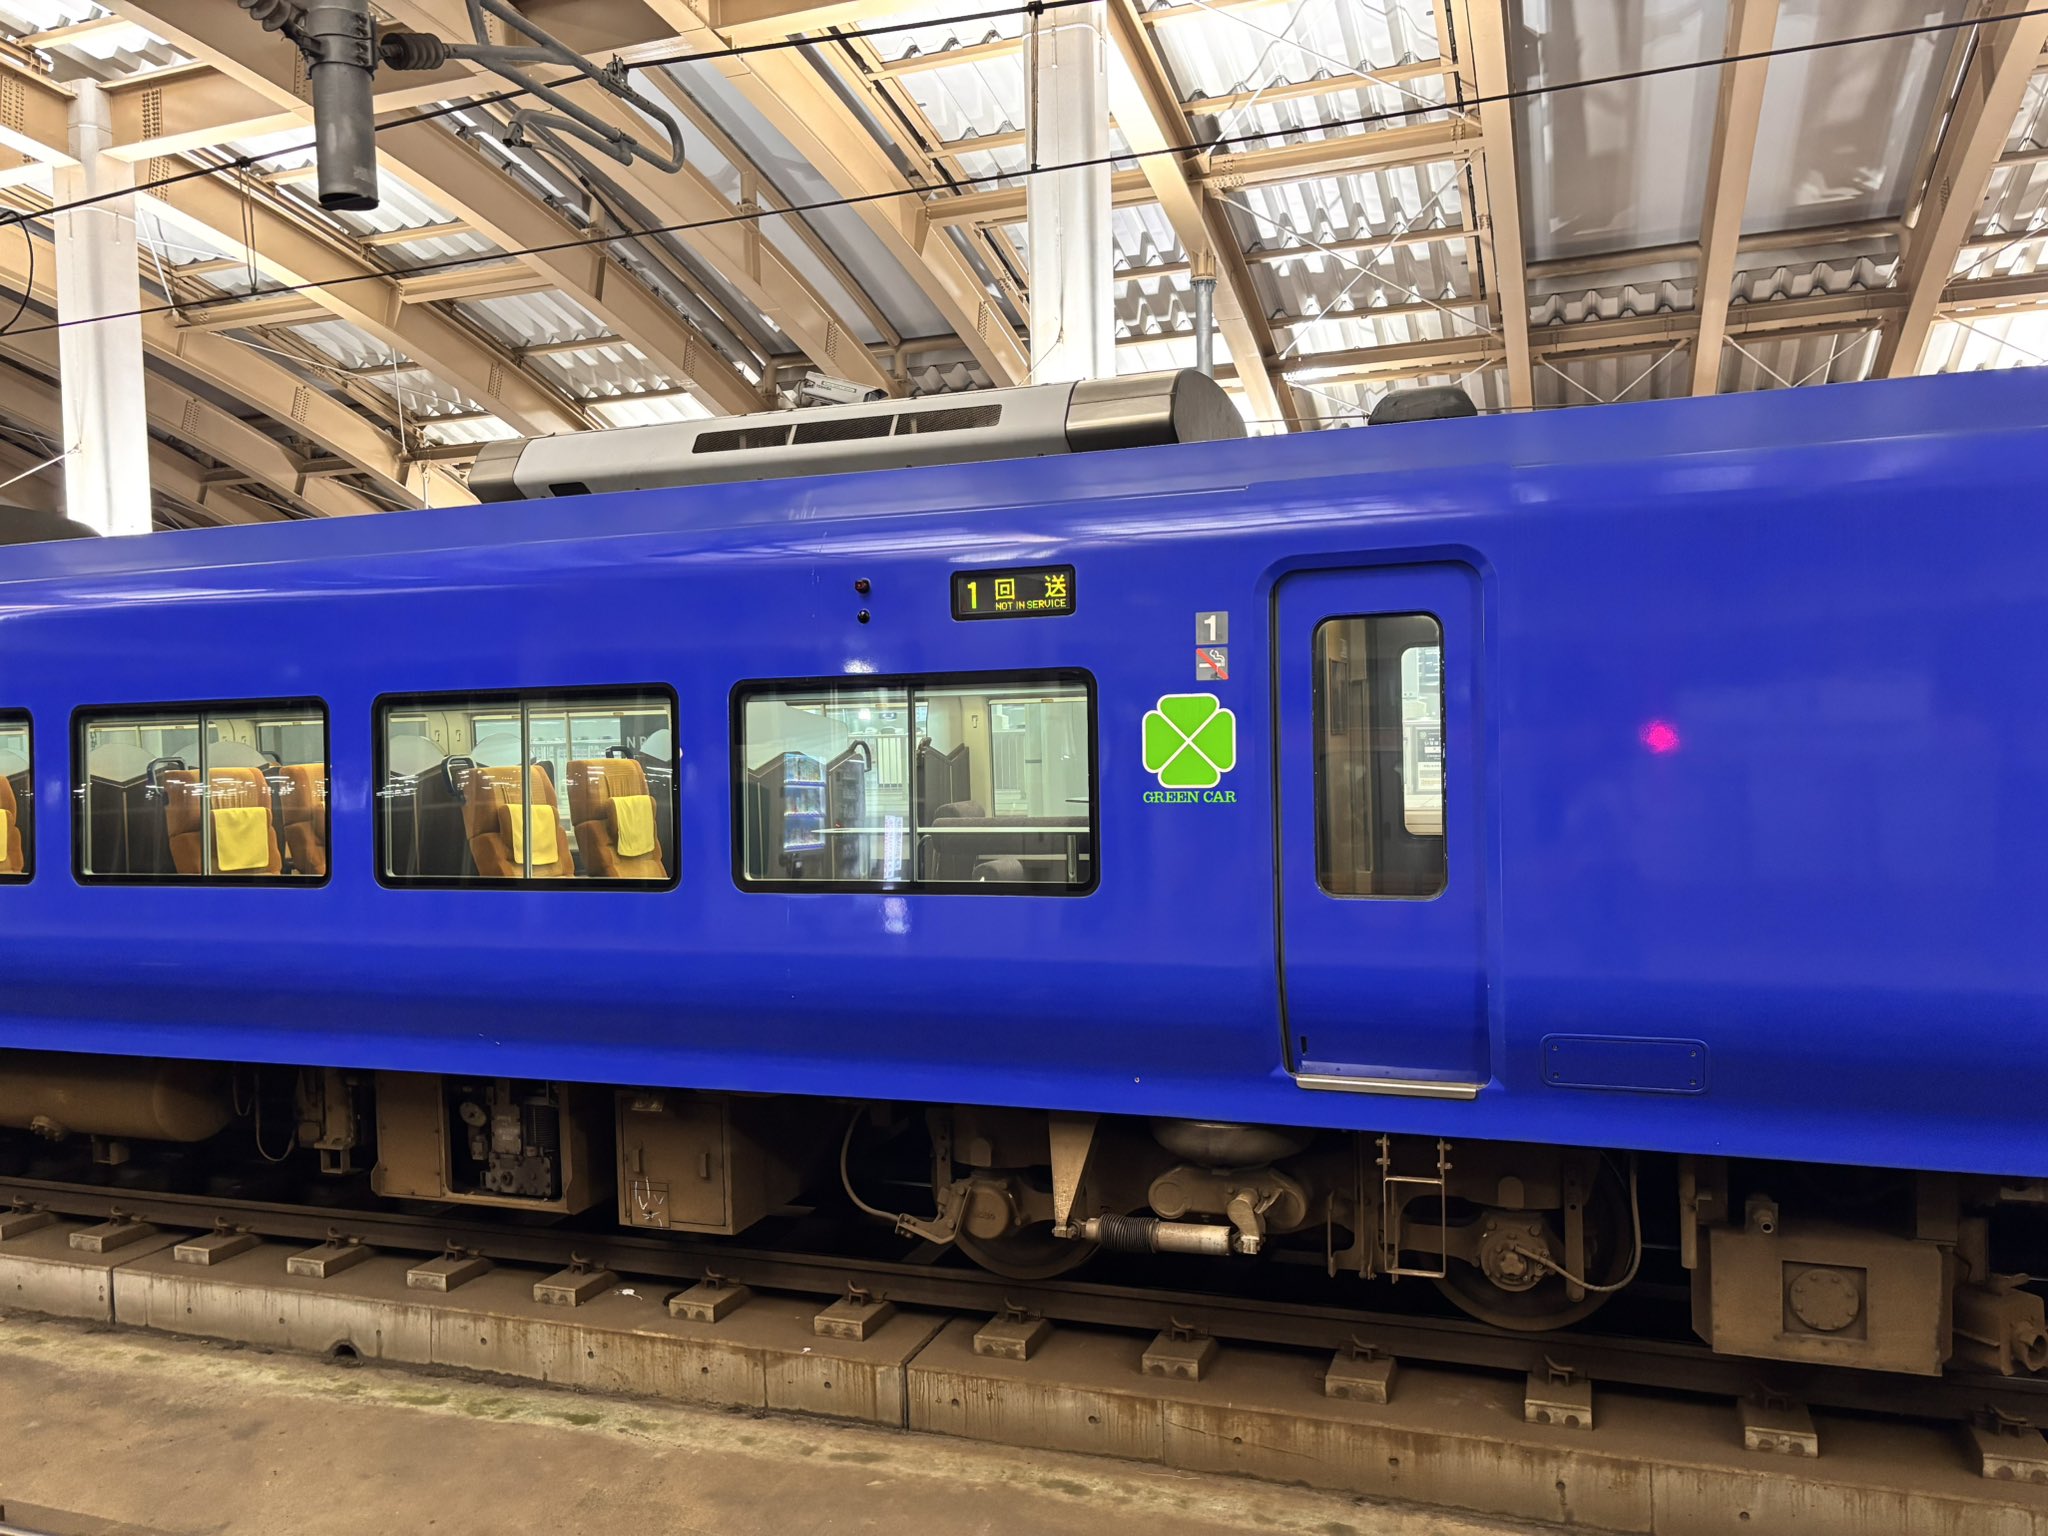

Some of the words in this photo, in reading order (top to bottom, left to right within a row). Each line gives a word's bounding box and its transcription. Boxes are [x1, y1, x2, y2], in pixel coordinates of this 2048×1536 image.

[967, 581, 977, 609] 1
[994, 574, 1067, 600] 回送
[995, 601, 1014, 611] NOT
[1016, 601, 1025, 610] IN
[1027, 598, 1067, 609] SERVICE
[1204, 614, 1217, 641] 1
[1143, 790, 1200, 804] GREEN
[1203, 790, 1237, 803] CAR
